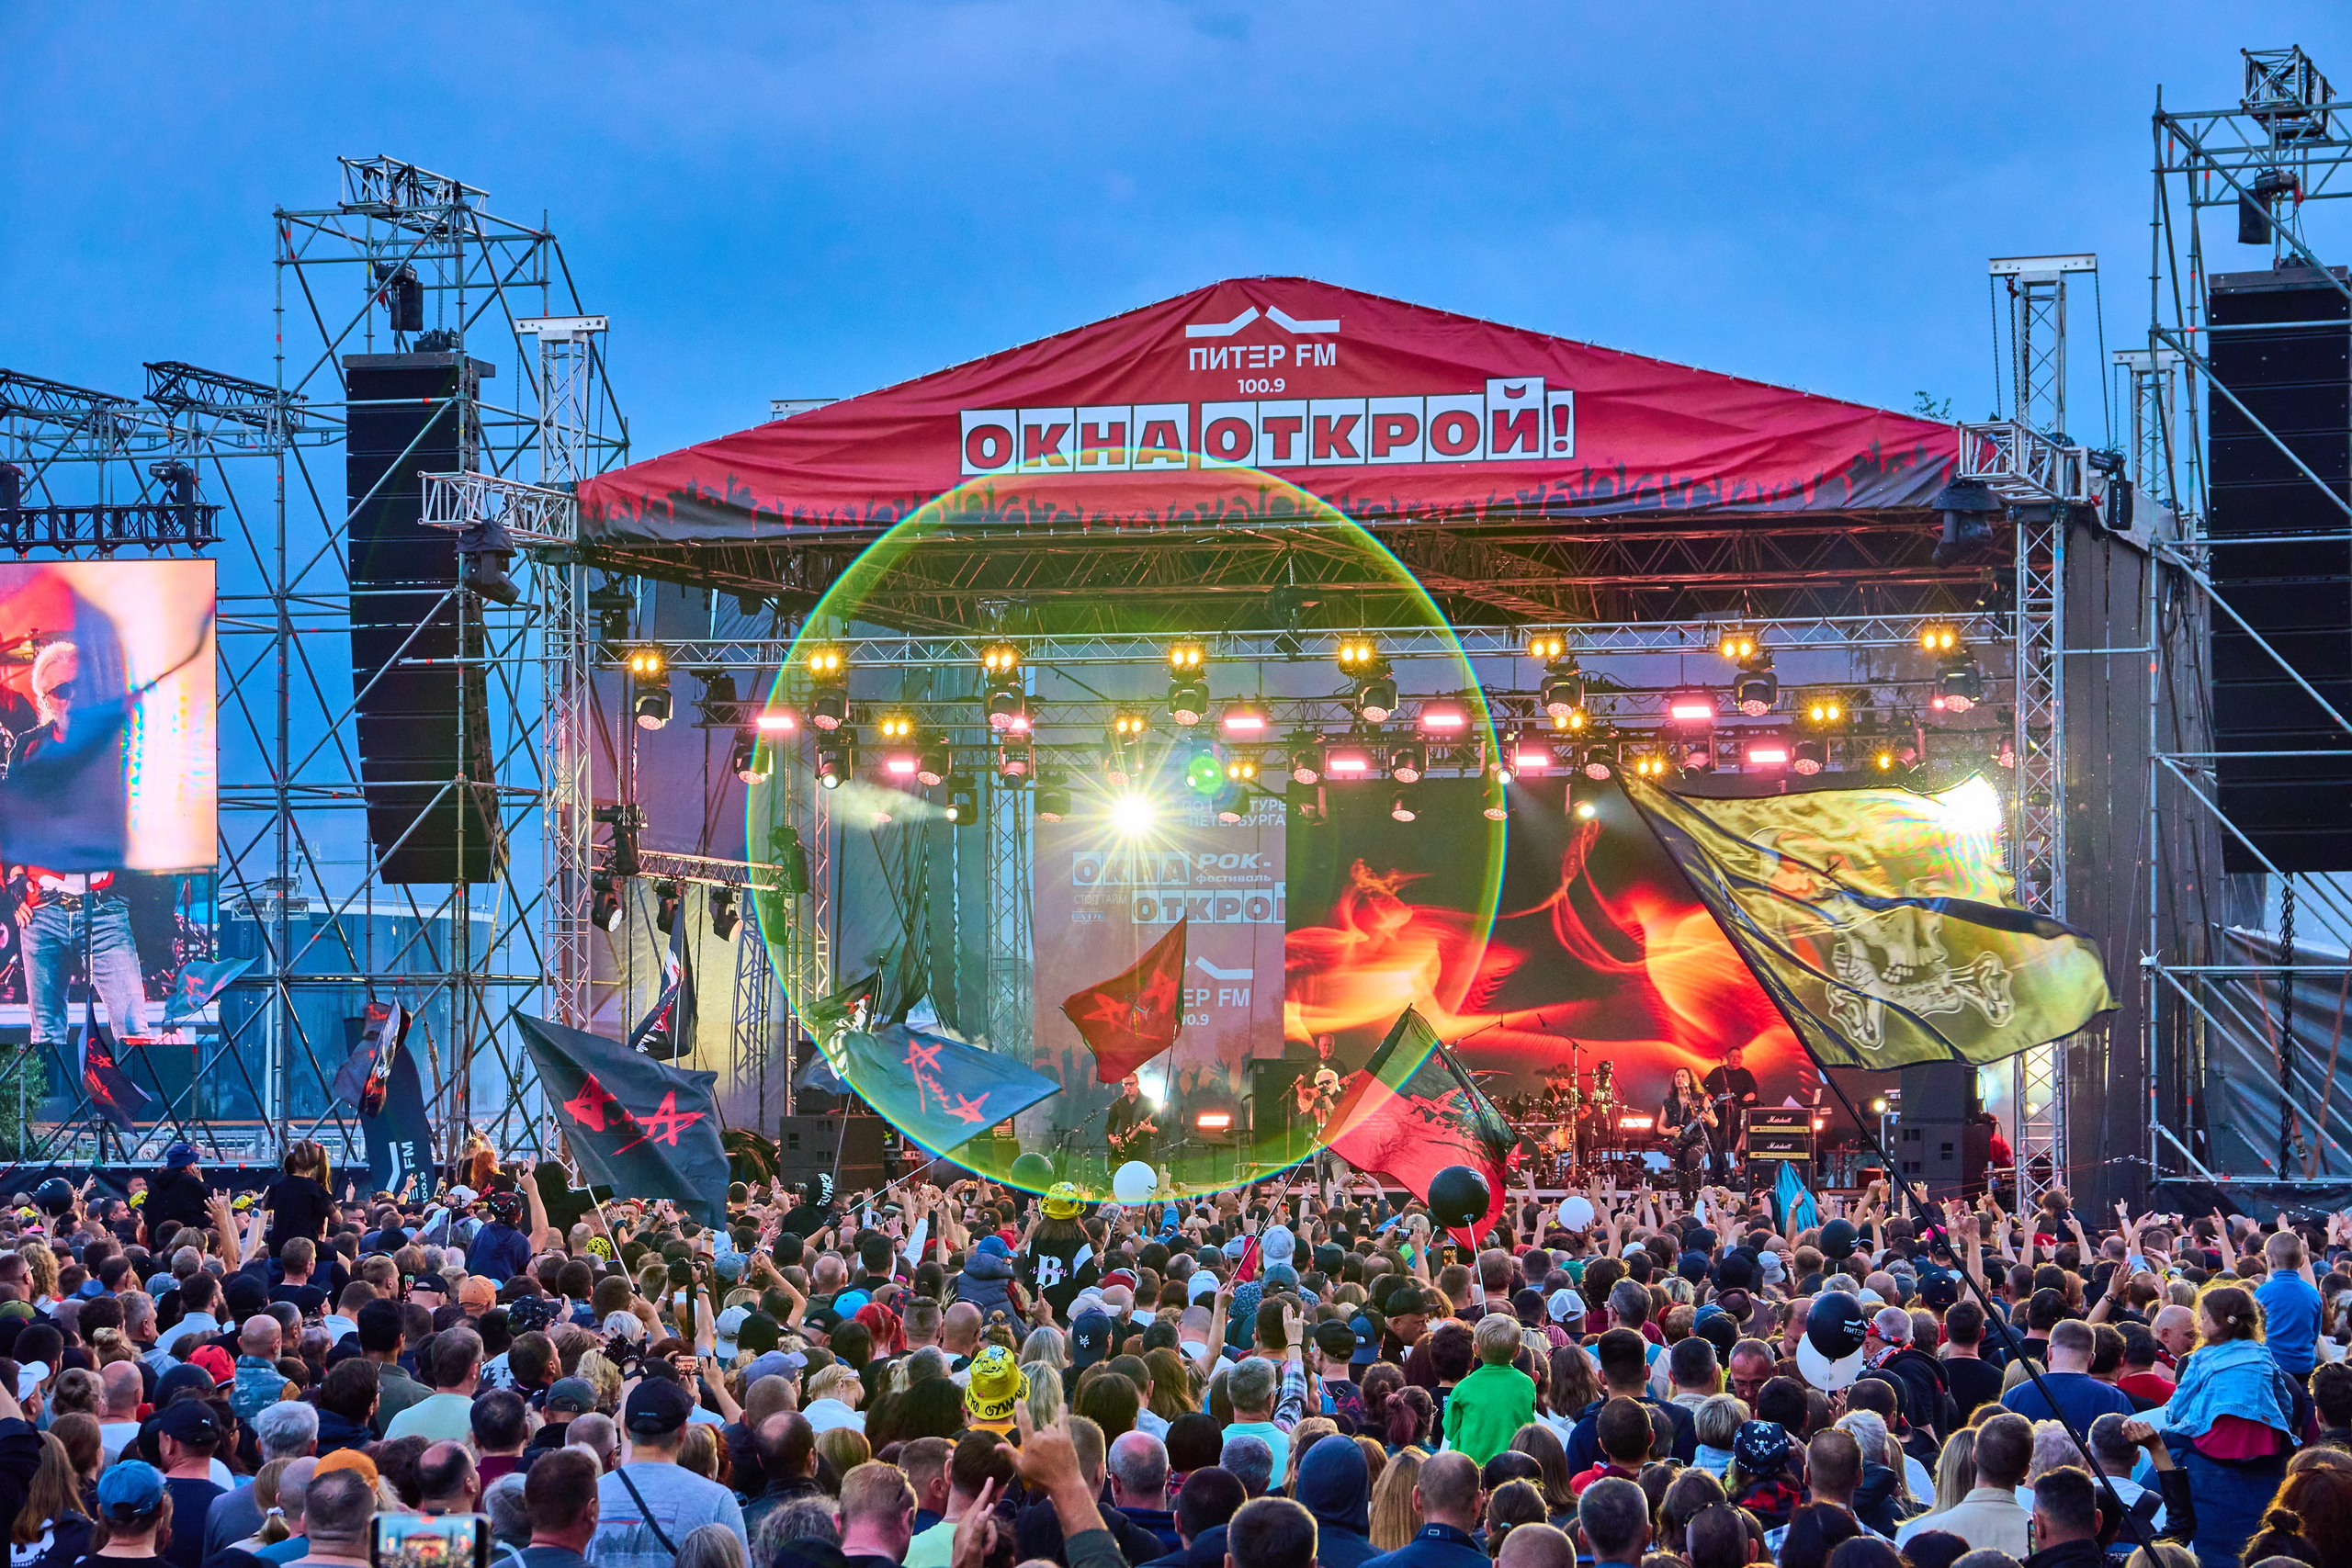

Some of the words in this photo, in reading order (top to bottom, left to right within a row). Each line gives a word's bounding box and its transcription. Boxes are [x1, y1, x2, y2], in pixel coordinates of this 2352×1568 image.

[1189, 344, 1286, 370] ПИТЕР
[1295, 343, 1336, 367] FM
[1238, 378, 1285, 394] 100.9
[964, 417, 1185, 470] ОКНА
[1204, 382, 1572, 467] ОТКРОЙ!
[1074, 858, 1189, 884] ОКНА
[1195, 874, 1272, 885] фестиваль
[1218, 987, 1250, 1007] FM
[1767, 1115, 1793, 1123] Marshall
[401, 1141, 415, 1169] FM
[1767, 1141, 1793, 1150] Marshall
